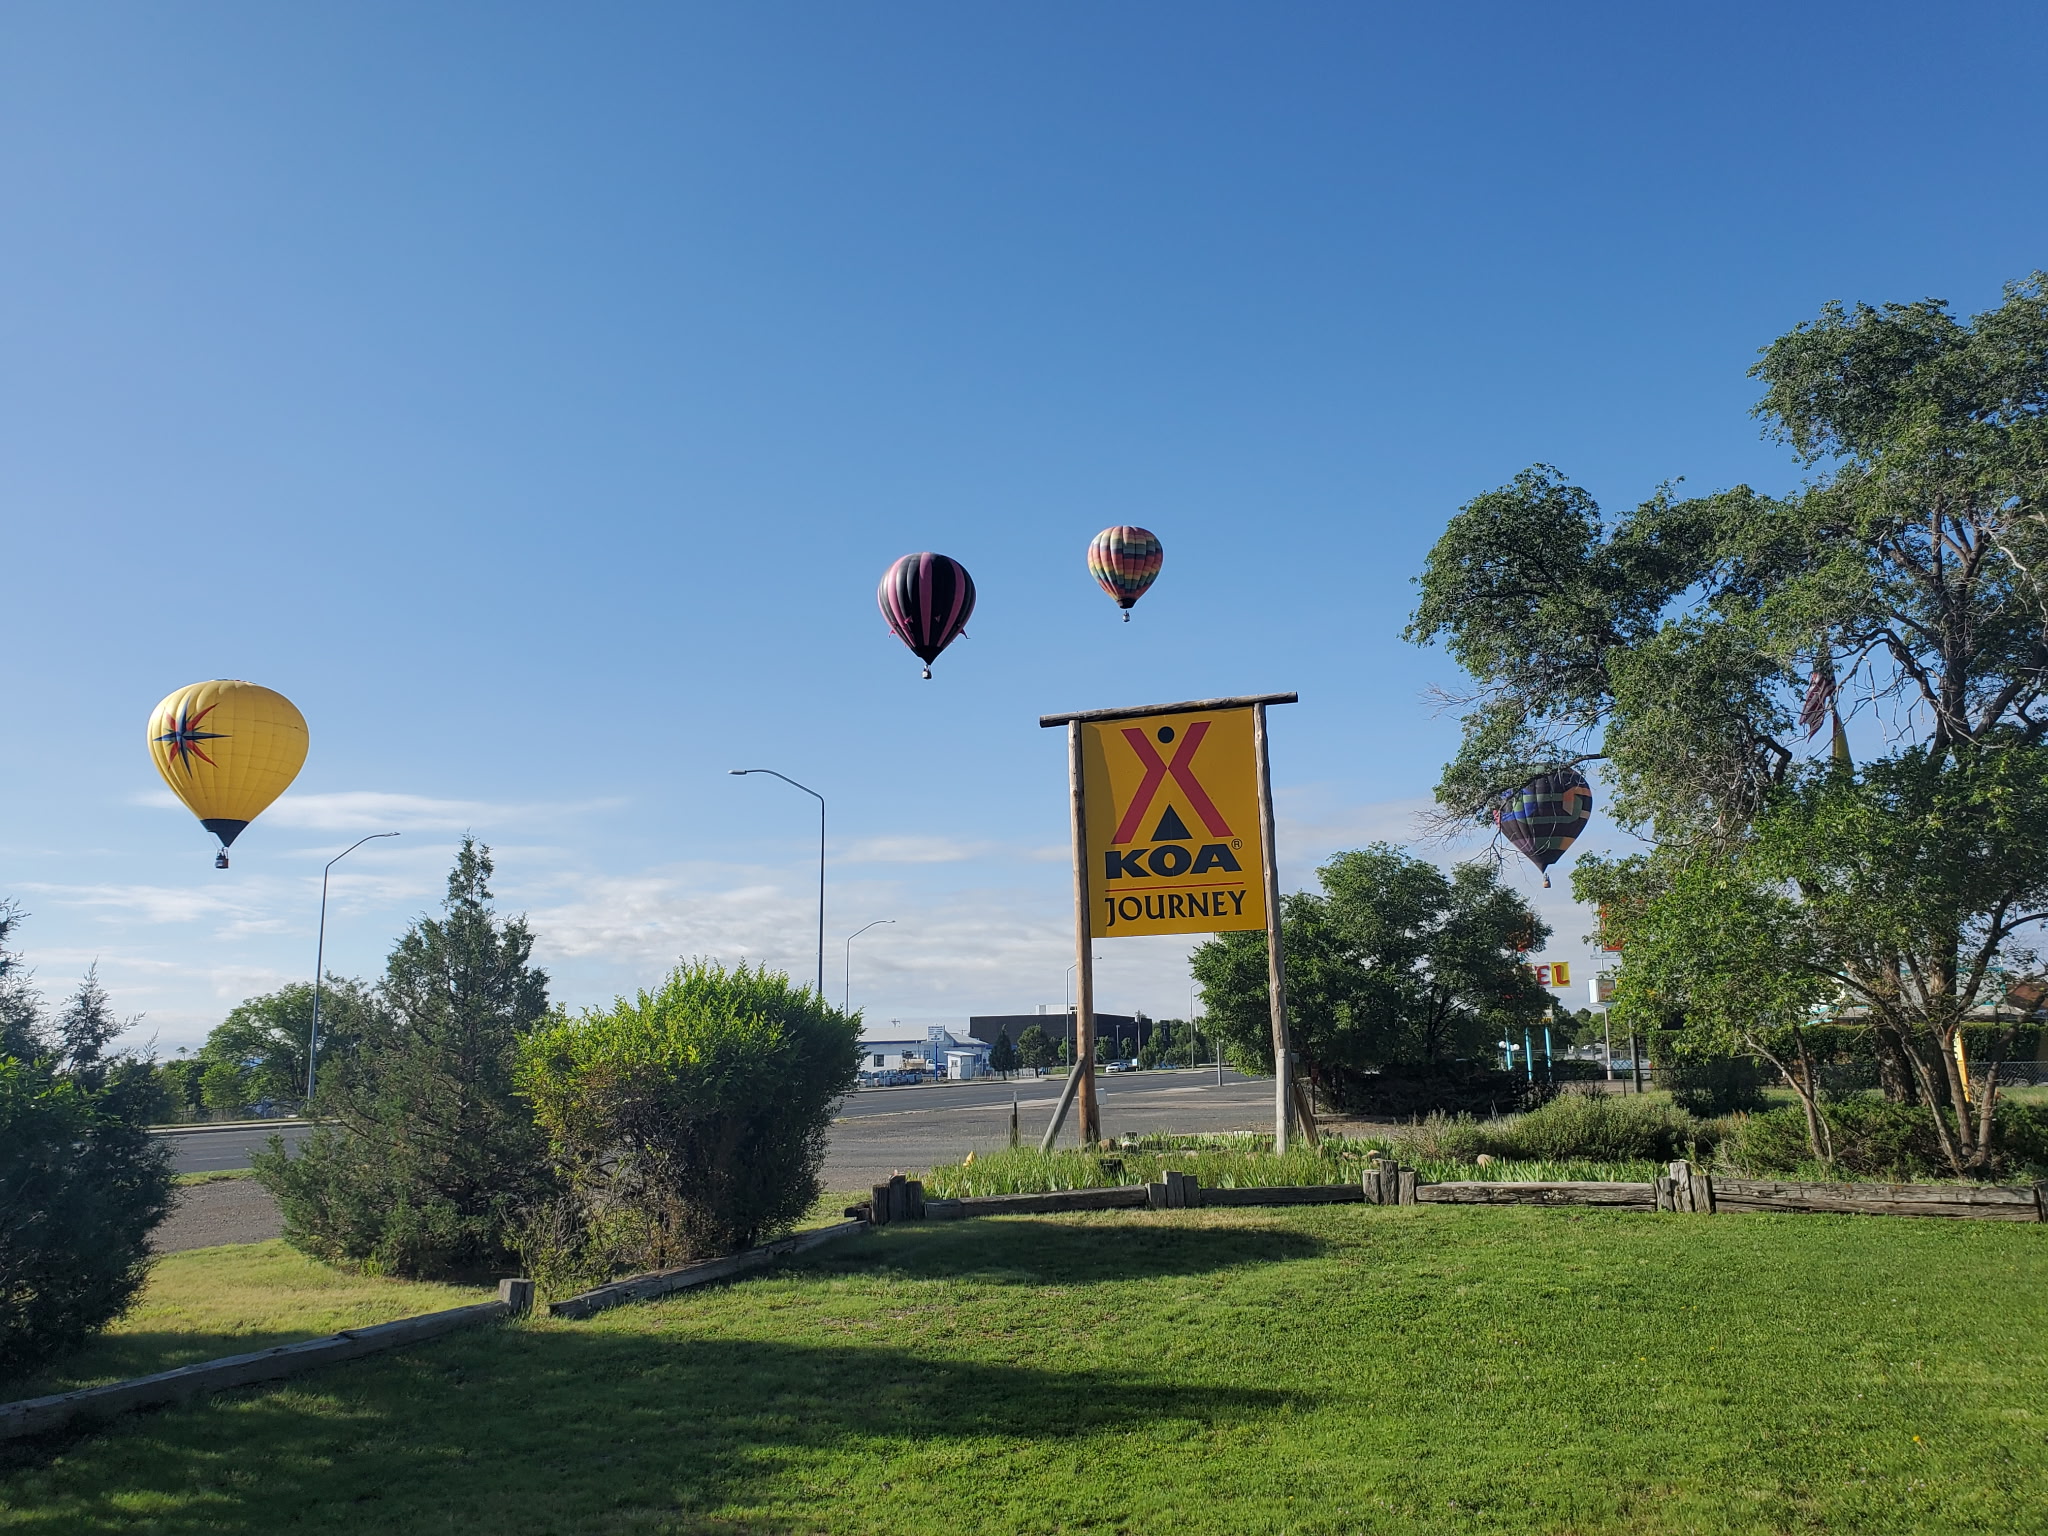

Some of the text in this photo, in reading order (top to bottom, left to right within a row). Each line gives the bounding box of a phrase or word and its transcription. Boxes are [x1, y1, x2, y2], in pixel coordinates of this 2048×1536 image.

[1105, 844, 1242, 879] KOA
[1104, 889, 1247, 927] JOURNEY
[1522, 964, 1570, 985] EL
